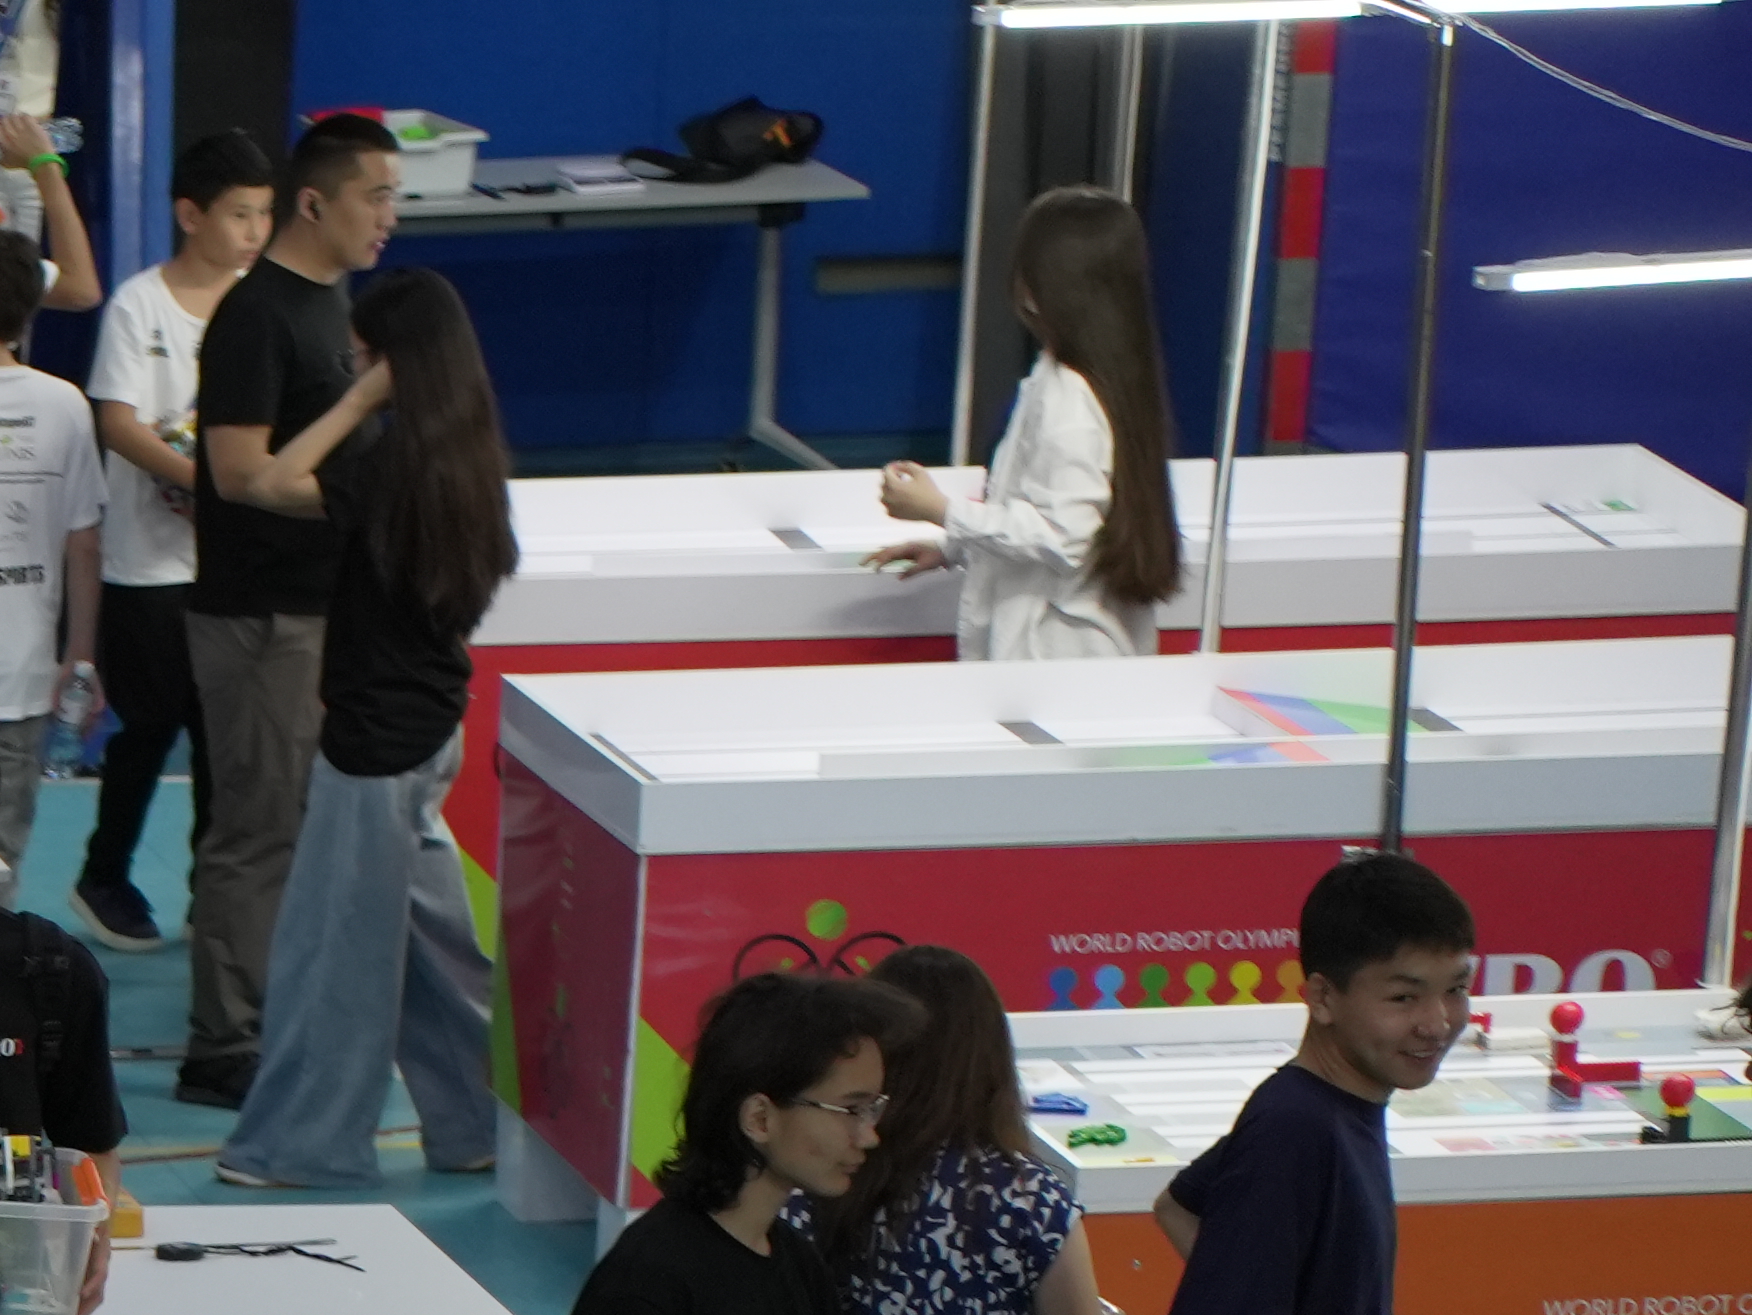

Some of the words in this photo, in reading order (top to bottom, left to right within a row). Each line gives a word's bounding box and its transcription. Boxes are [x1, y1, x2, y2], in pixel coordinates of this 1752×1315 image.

[1048, 932, 1132, 956] WORLD
[1135, 930, 1212, 953] ROBOT
[1215, 929, 1302, 952] OLYMPI
